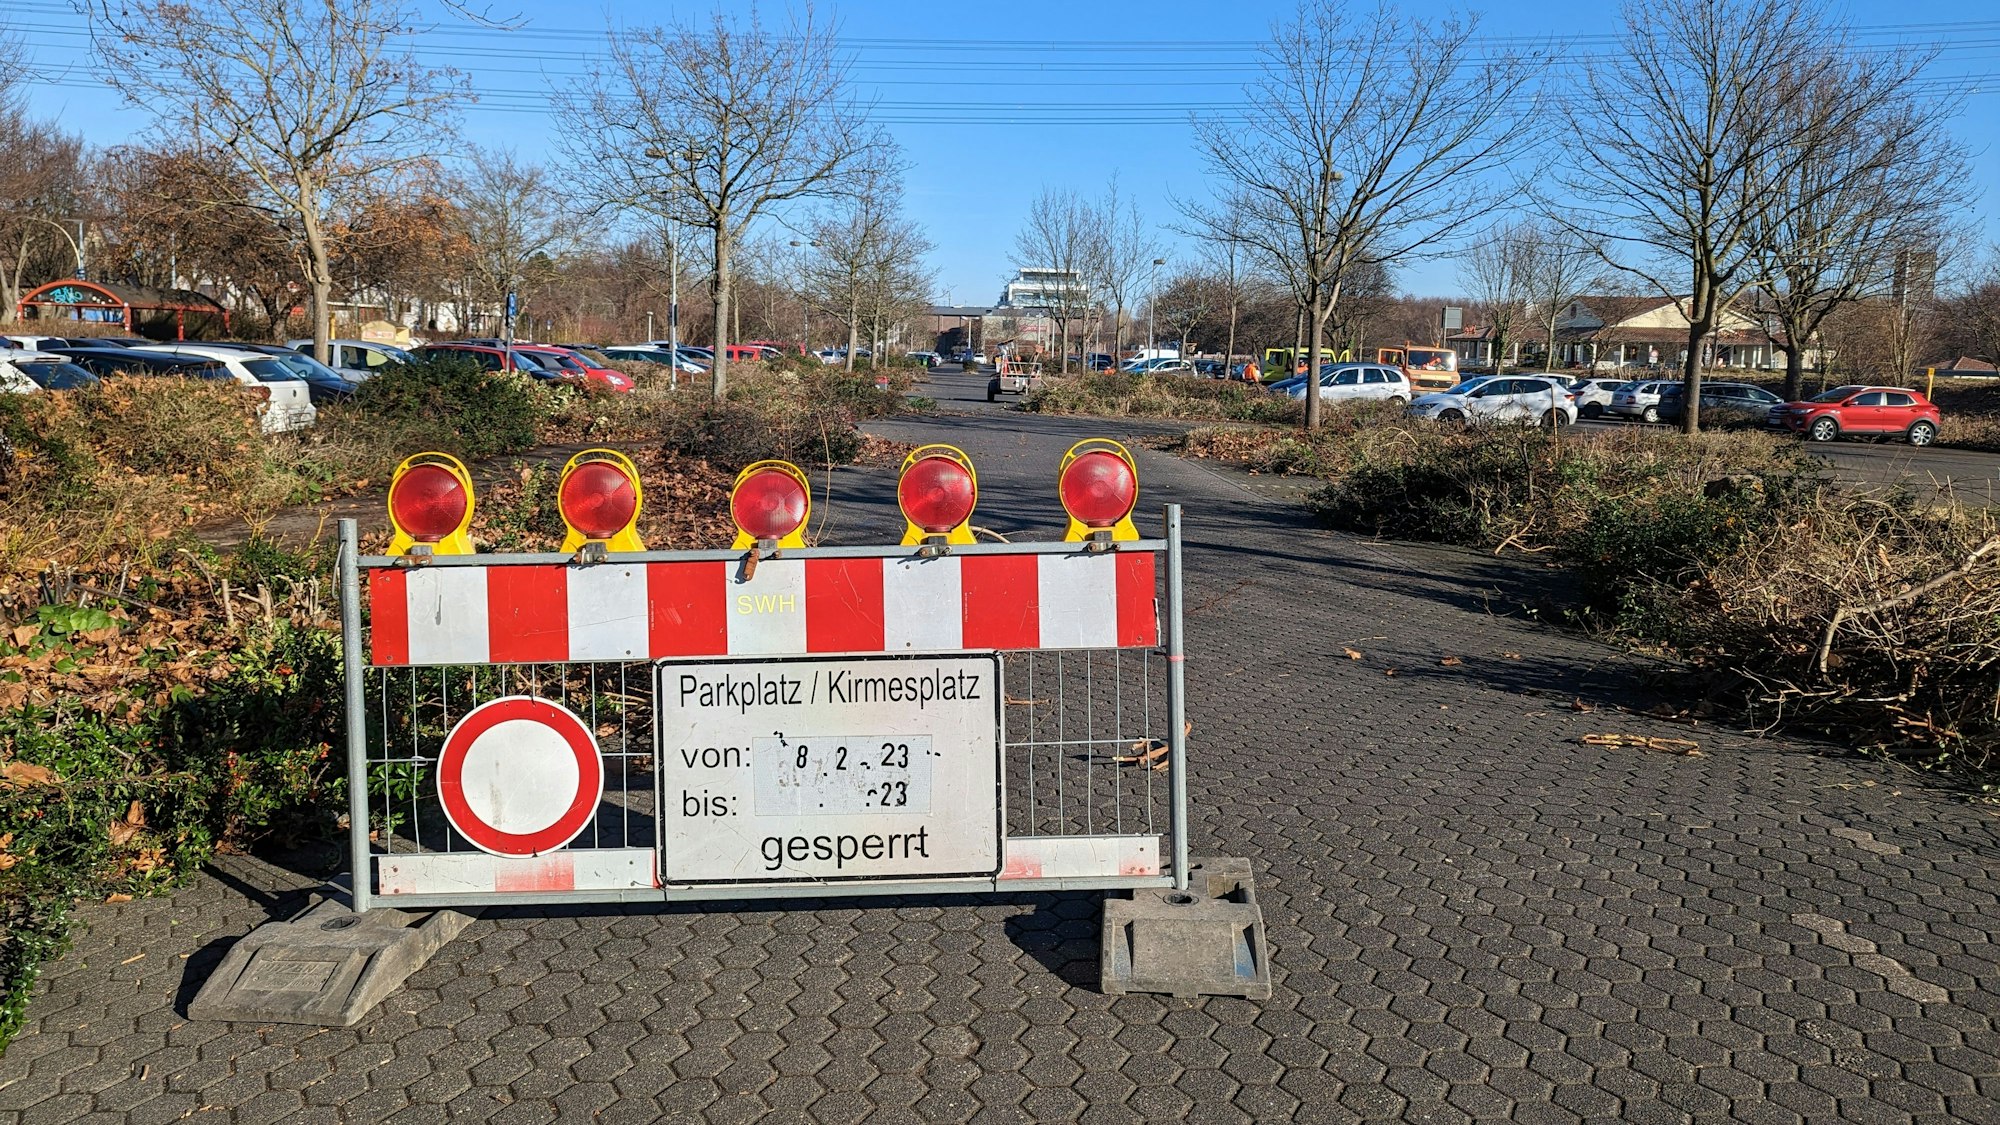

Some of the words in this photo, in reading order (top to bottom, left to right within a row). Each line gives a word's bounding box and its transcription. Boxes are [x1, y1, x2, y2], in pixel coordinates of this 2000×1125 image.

[736, 594, 796, 615] SWH
[679, 672, 803, 715] Parkplatz
[828, 667, 981, 710] Kirmesplatz
[680, 746, 751, 769] von:
[879, 742, 909, 769] 23
[682, 788, 737, 818] bis:
[761, 825, 930, 871] gesperrt
